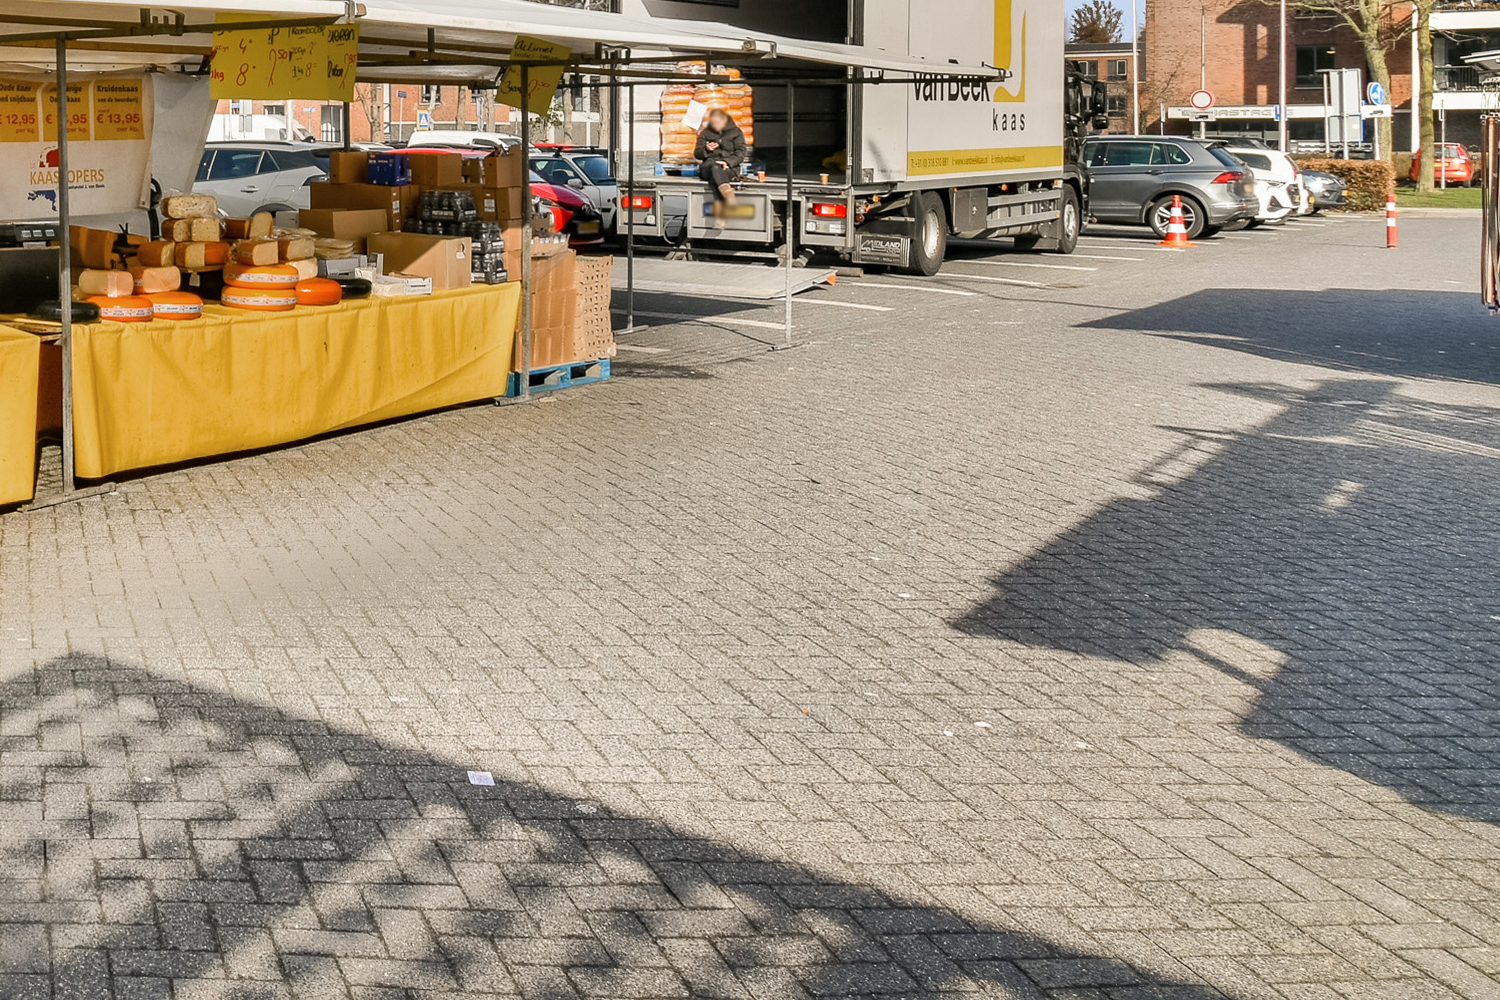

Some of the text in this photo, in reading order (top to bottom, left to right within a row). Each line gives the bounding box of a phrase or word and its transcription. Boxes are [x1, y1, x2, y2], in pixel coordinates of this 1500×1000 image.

[0, 83, 31, 92] Oude kaas
[97, 85, 138, 93] Kruidenkaas
[6, 114, 36, 126] 12,95
[45, 115, 52, 124] €
[97, 113, 140, 125] € 13,95
[992, 108, 1025, 131] kaas
[30, 169, 105, 185] KAASOPERS
